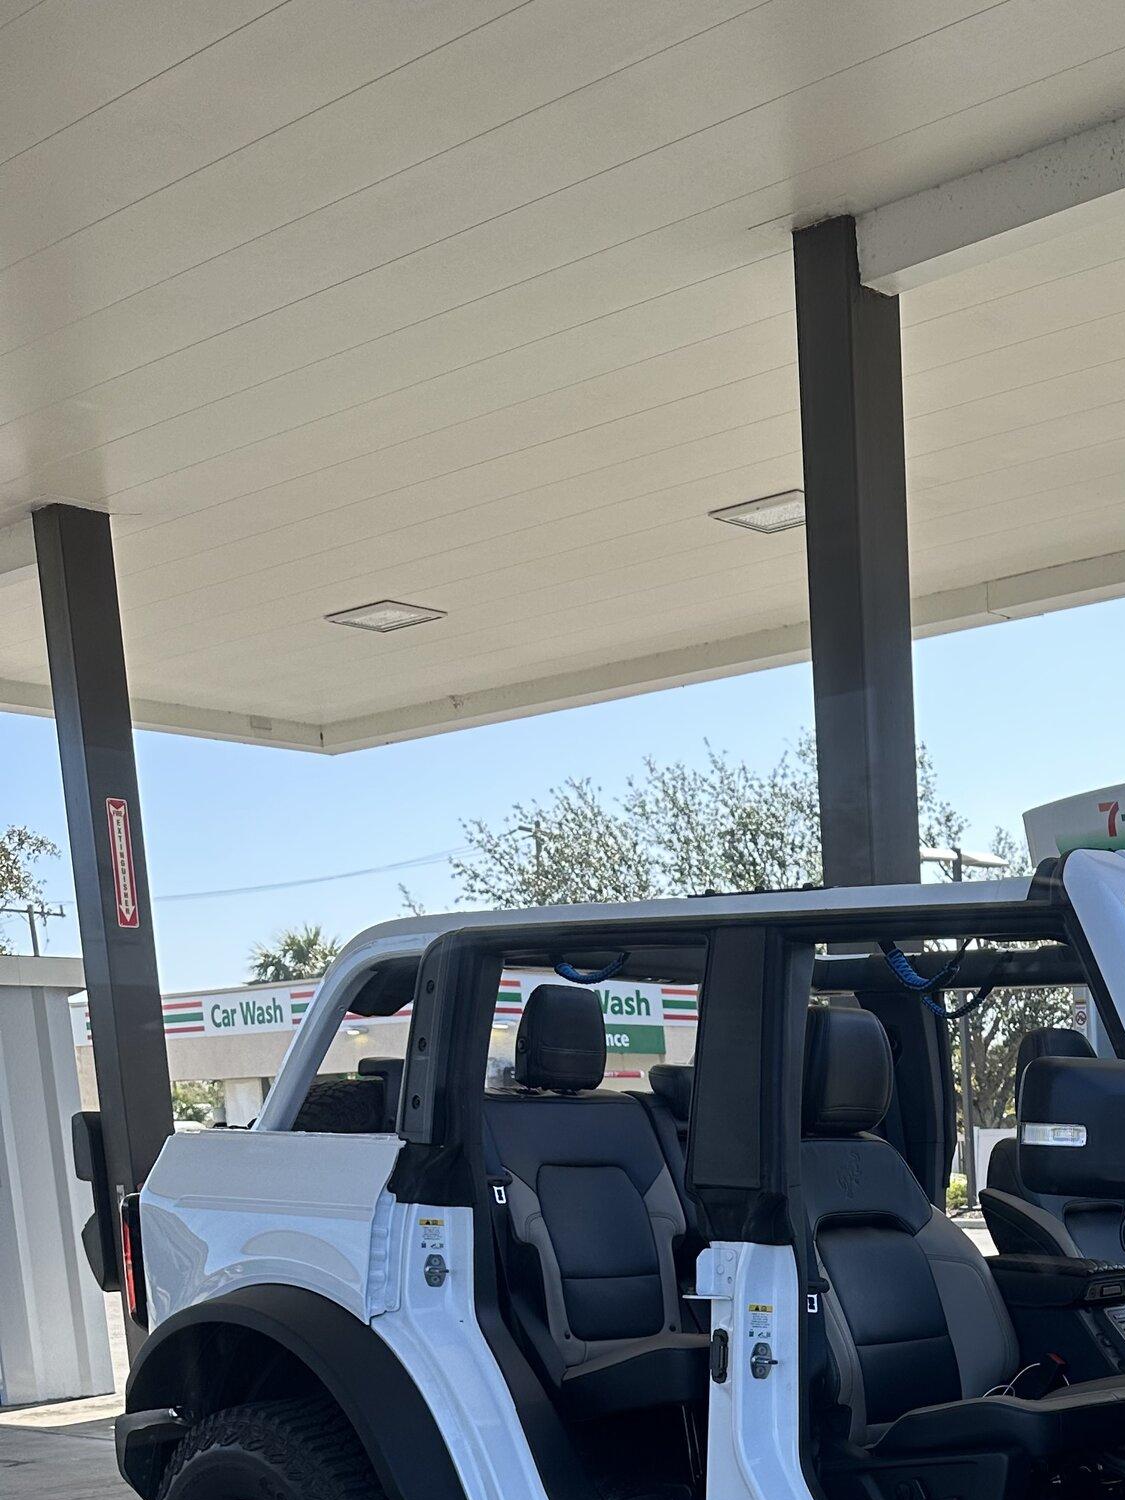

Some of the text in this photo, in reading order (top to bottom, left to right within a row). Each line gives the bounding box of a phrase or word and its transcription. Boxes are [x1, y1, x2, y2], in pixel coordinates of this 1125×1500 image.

[116, 820, 131, 915] EXTINGUISHER
[211, 997, 284, 1028] Car Wash
